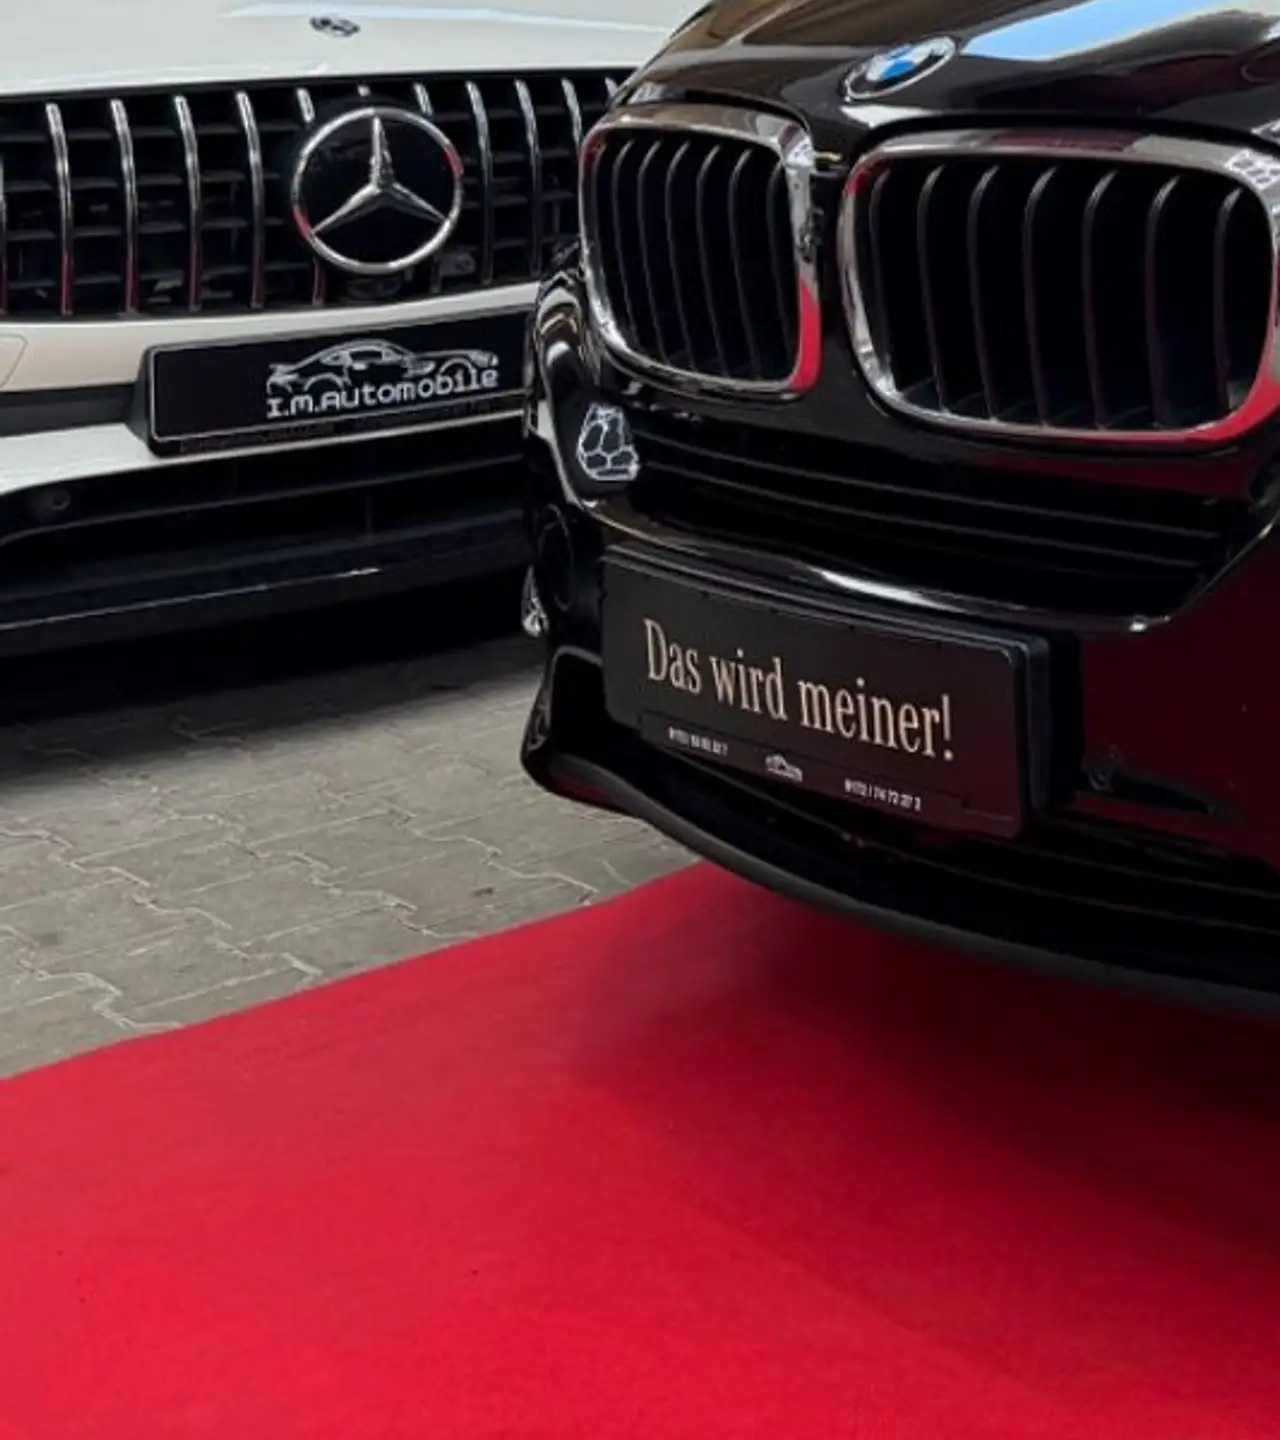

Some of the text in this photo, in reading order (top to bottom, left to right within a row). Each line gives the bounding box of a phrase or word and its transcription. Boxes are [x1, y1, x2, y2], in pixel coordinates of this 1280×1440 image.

[643, 617, 701, 694] Das
[710, 647, 788, 721] wird
[797, 676, 954, 761] meiner!
